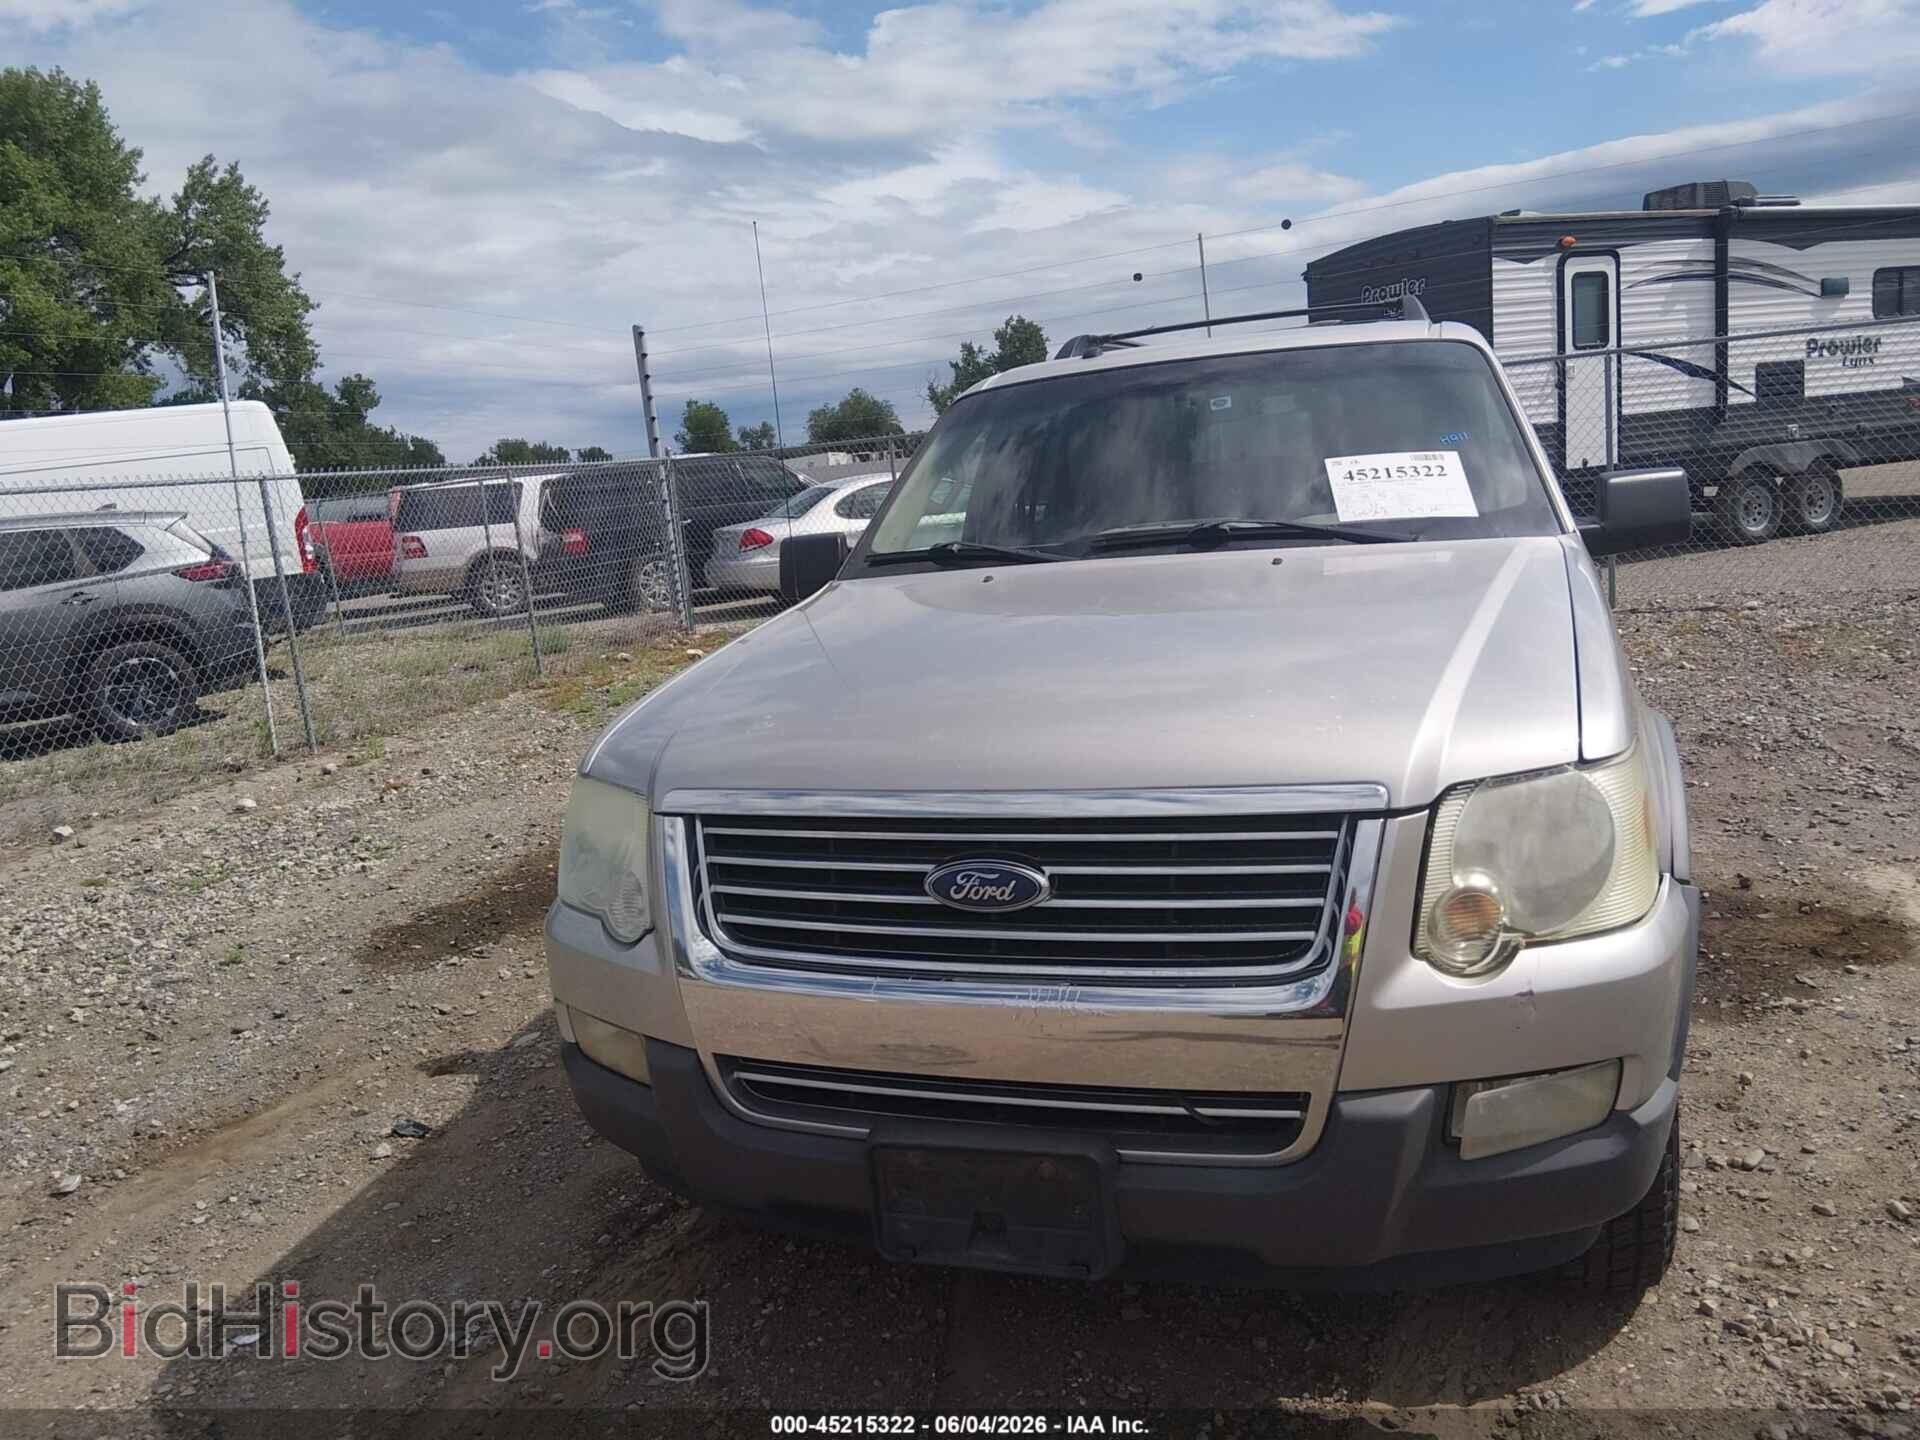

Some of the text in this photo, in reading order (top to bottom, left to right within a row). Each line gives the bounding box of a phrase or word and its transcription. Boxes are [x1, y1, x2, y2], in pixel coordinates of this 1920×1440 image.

[1361, 278, 1426, 304] Prowler
[1806, 335, 1882, 359] Prowler
[1343, 464, 1448, 482] 45215322
[950, 871, 1017, 901] Ford
